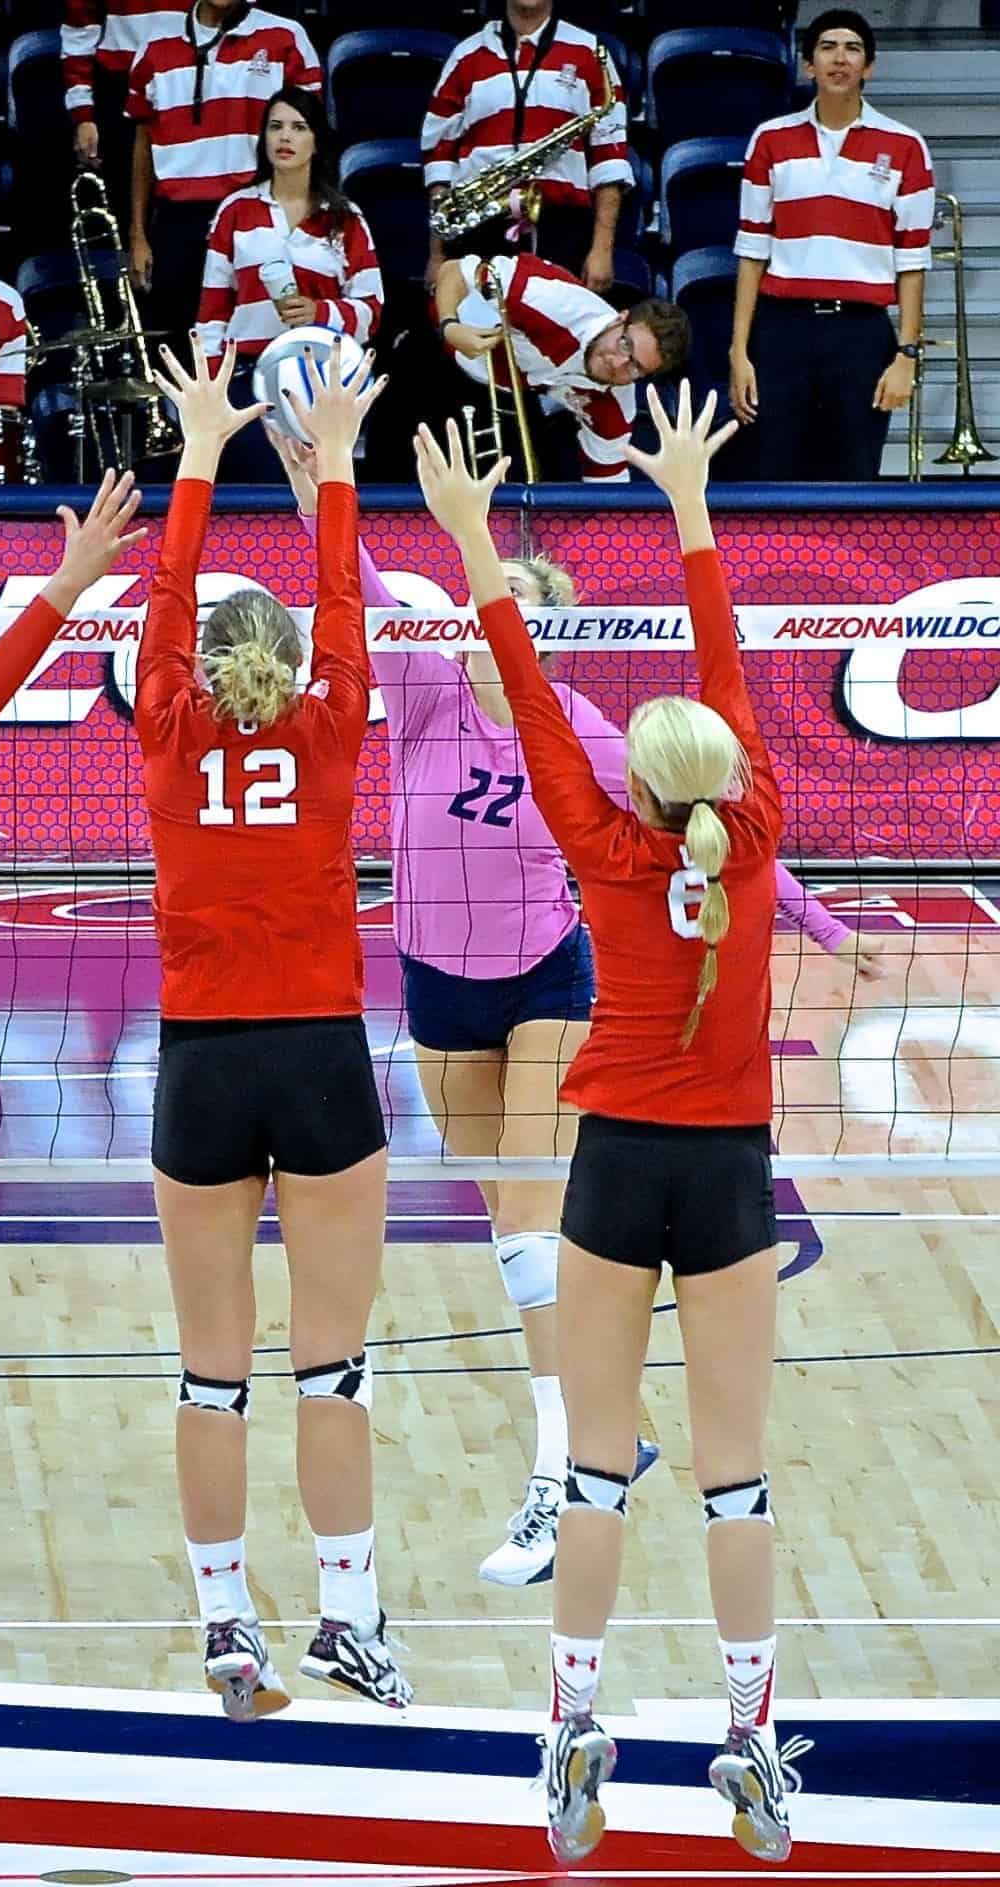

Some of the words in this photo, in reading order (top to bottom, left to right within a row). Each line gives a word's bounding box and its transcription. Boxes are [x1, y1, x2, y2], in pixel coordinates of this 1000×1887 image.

[774, 616, 1000, 639] ARIZONAWILDC
[198, 747, 298, 826] 12
[447, 766, 525, 829] 22
